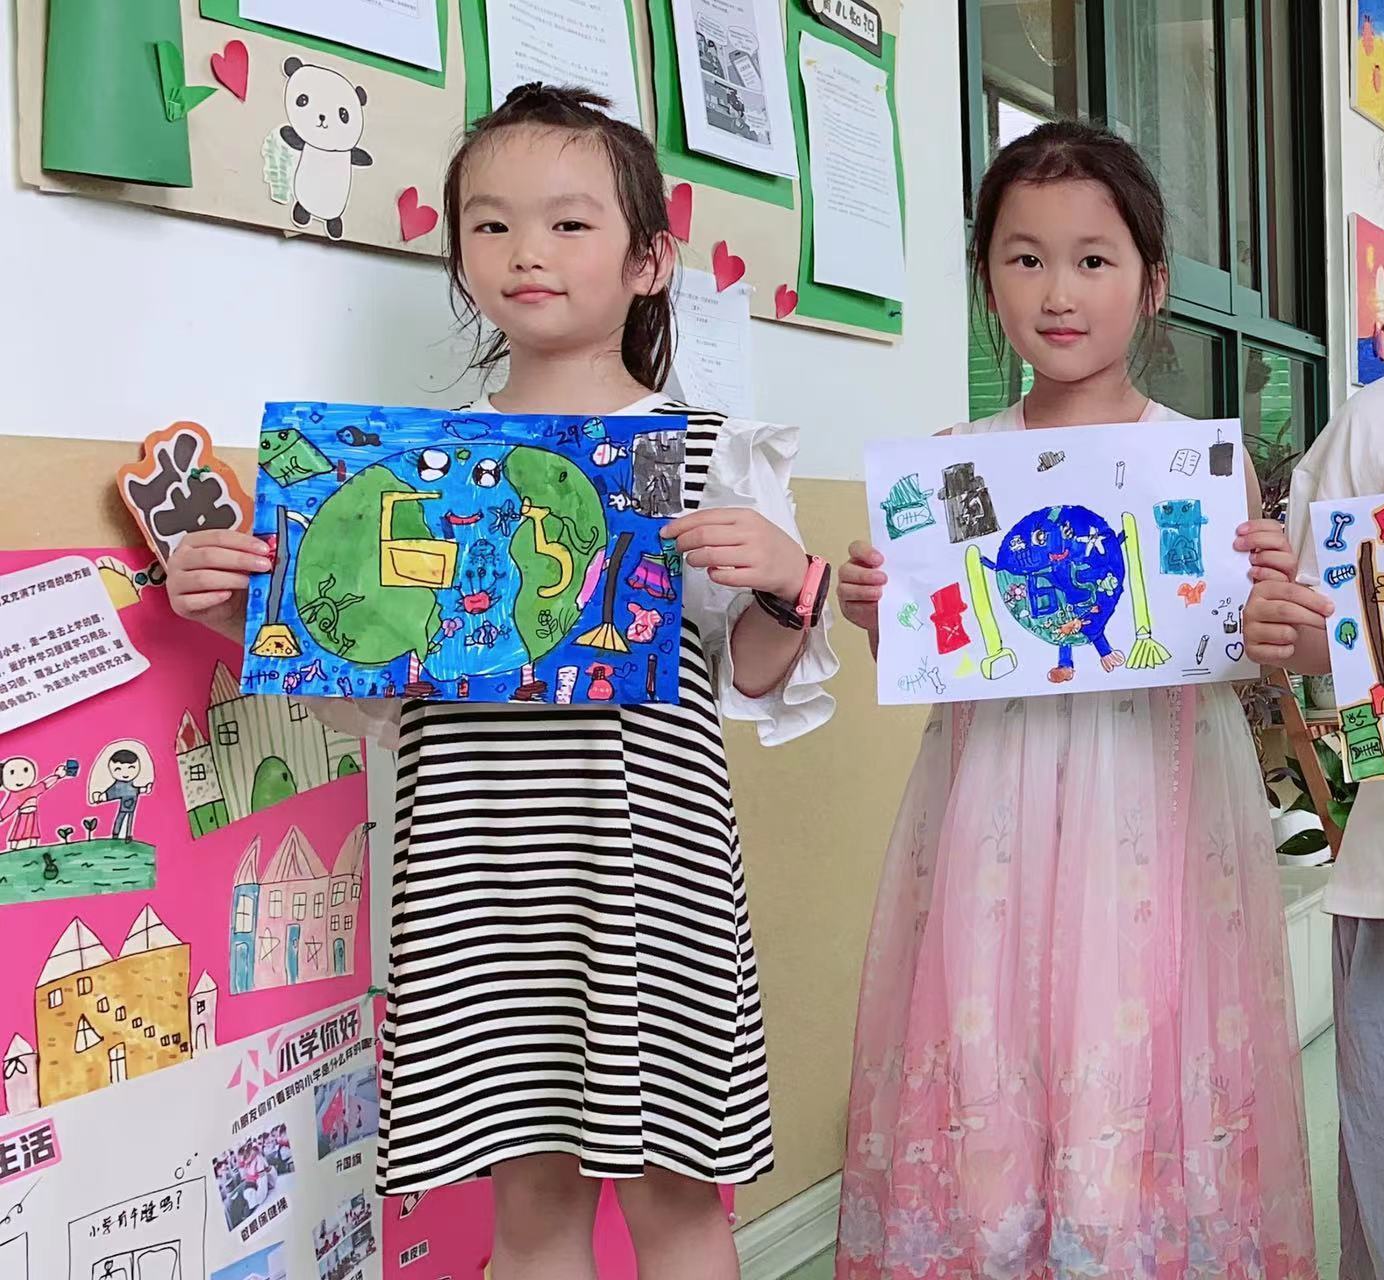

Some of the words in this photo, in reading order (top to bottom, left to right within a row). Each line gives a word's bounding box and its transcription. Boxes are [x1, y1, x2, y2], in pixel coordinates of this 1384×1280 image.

[279, 1009, 357, 1073] 小学你好
[0, 1124, 56, 1179] 生活
